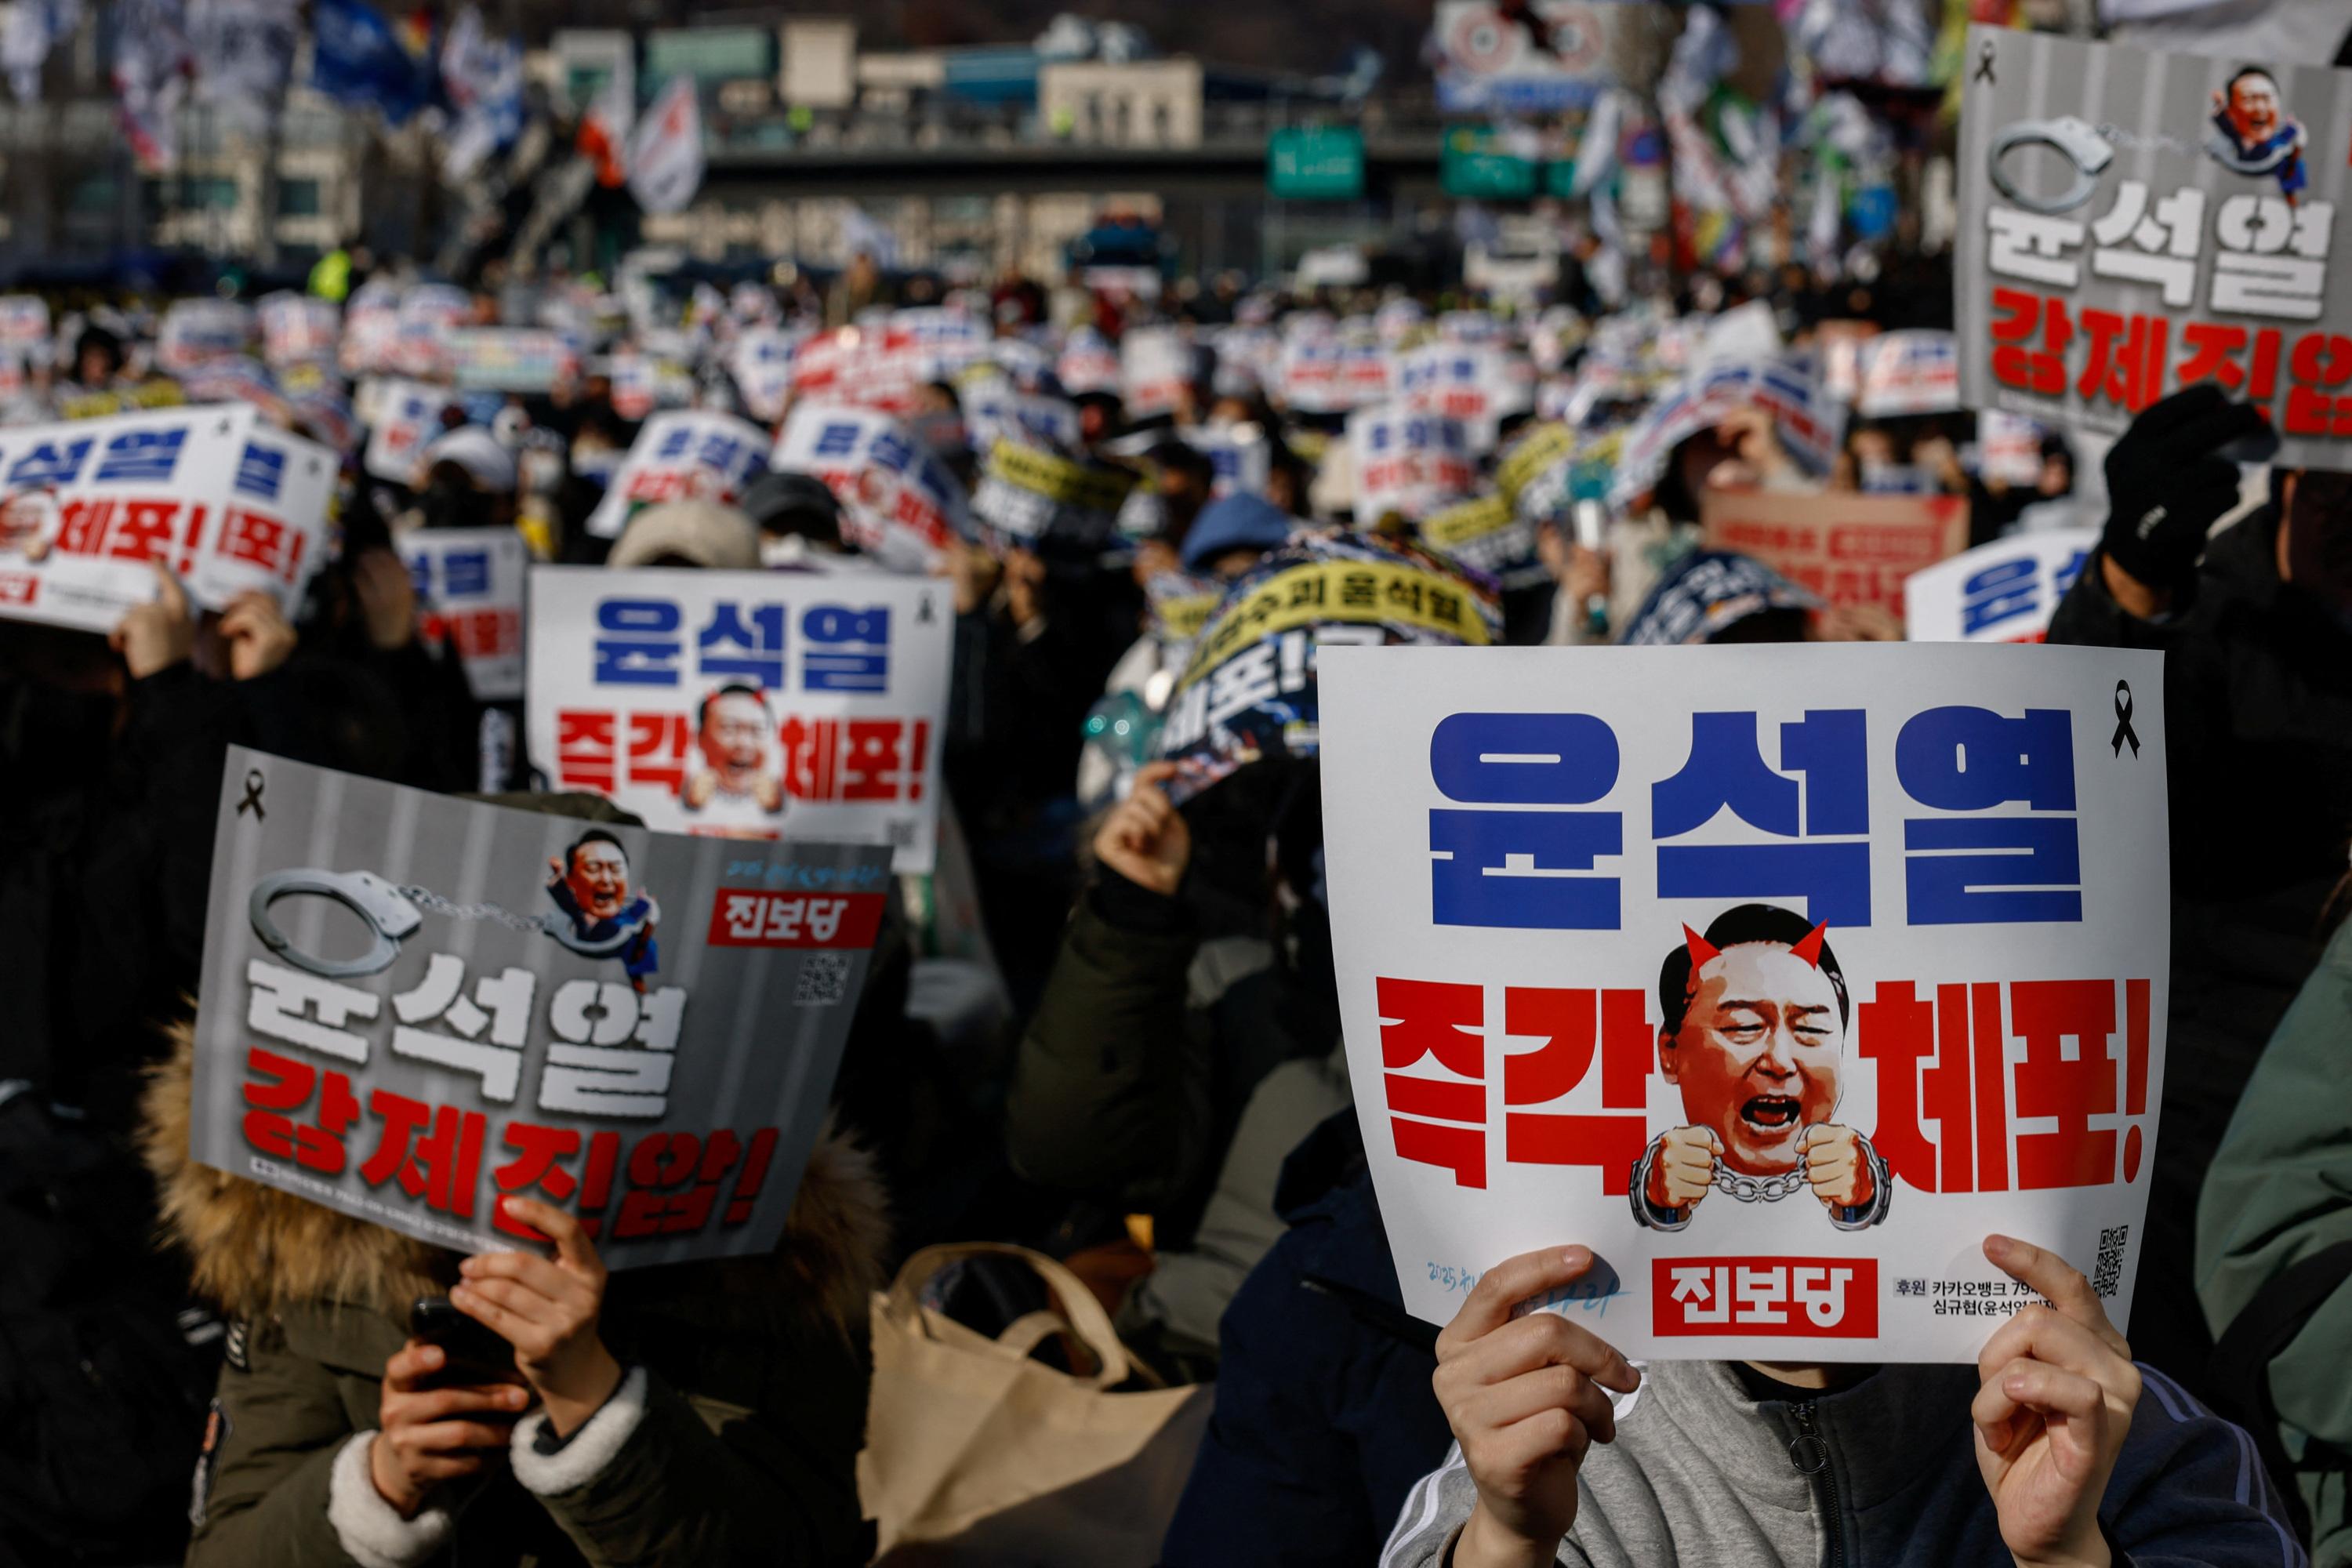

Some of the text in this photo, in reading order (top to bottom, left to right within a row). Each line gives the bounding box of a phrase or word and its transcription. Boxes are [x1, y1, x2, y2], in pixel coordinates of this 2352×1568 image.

[1987, 115, 2334, 320] 윤석열
[0, 429, 189, 483] 석열
[593, 599, 892, 693] 윤석열
[558, 711, 930, 803] 즉각 체포!
[1429, 705, 2082, 930] 윤석열
[725, 895, 848, 942] 진보당
[247, 868, 687, 1117] 윤석열
[1376, 975, 2151, 1196] 즉각 체포!
[242, 1047, 779, 1242] 강제진압!
[1671, 1266, 1853, 1327] 진보당
[1896, 1279, 1926, 1295] 후원
[1932, 1281, 2007, 1297] 카카오뱅크
